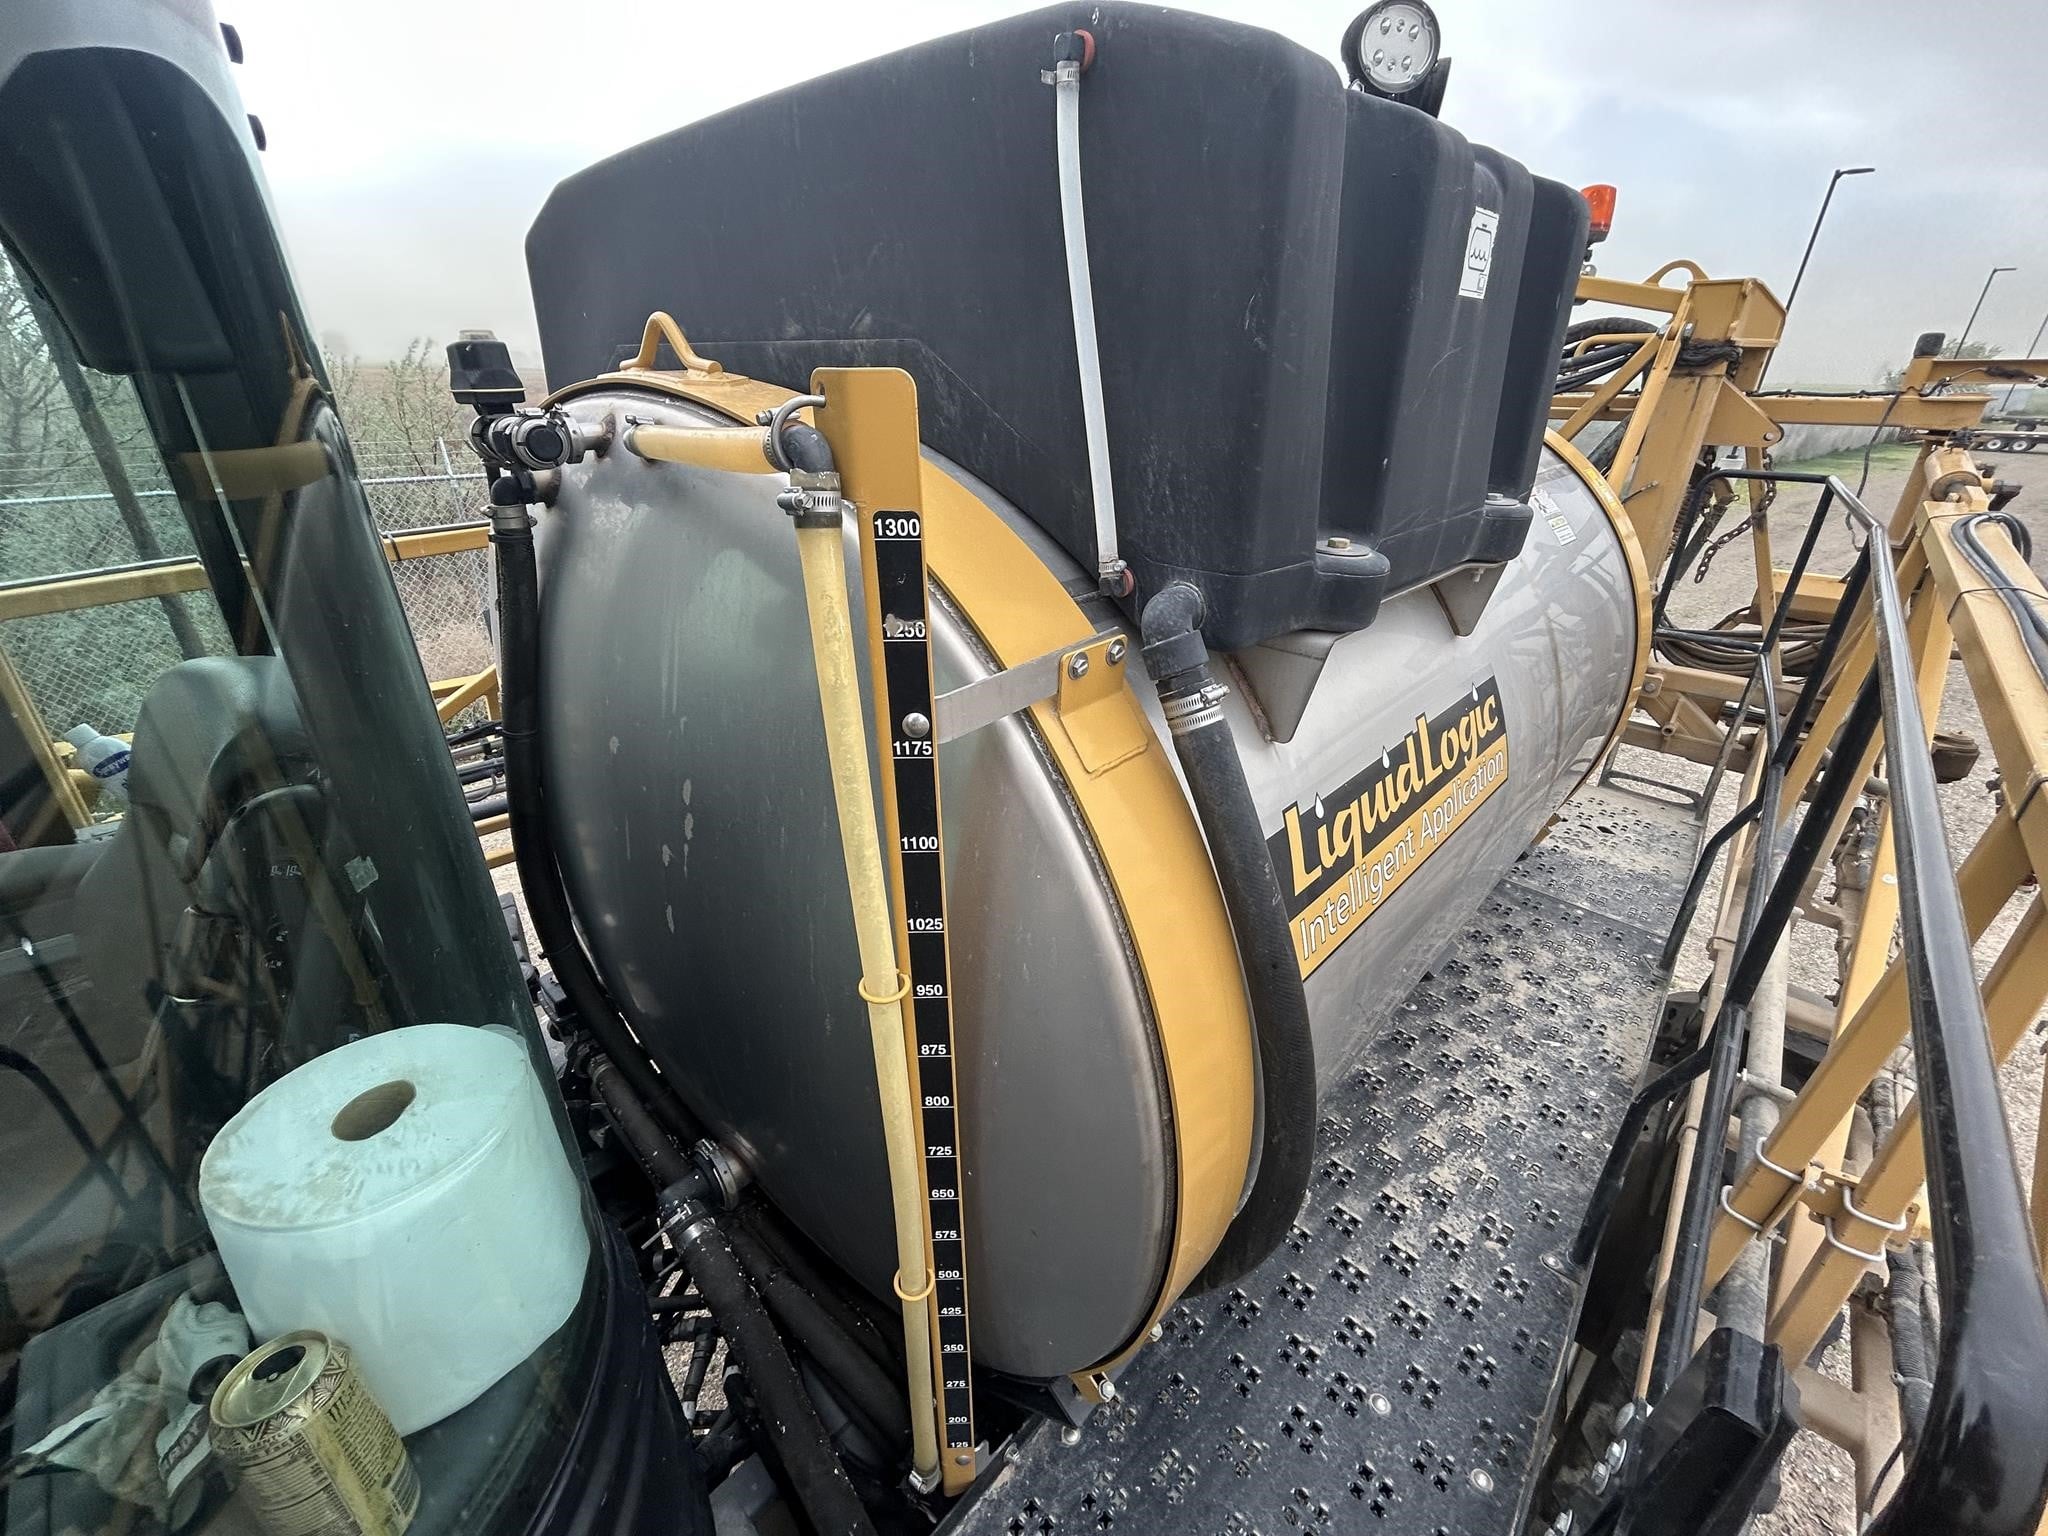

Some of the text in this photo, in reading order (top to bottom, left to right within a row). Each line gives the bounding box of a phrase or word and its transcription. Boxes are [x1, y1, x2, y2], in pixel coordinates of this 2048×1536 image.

[874, 518, 920, 537] 1300
[893, 740, 933, 756] 1175
[1283, 686, 1499, 896] LiquidLogic
[901, 836, 938, 850] 1100
[1299, 748, 1505, 961] Intelligent Application
[908, 918, 943, 931] 1025
[916, 985, 943, 996] 950
[921, 1044, 947, 1055] 875
[925, 1096, 950, 1106] 800
[928, 1146, 952, 1156] 725
[931, 1189, 955, 1198] 650
[935, 1230, 957, 1239] 575
[938, 1270, 960, 1278] 500
[941, 1307, 962, 1315] 425
[943, 1344, 964, 1352] 350
